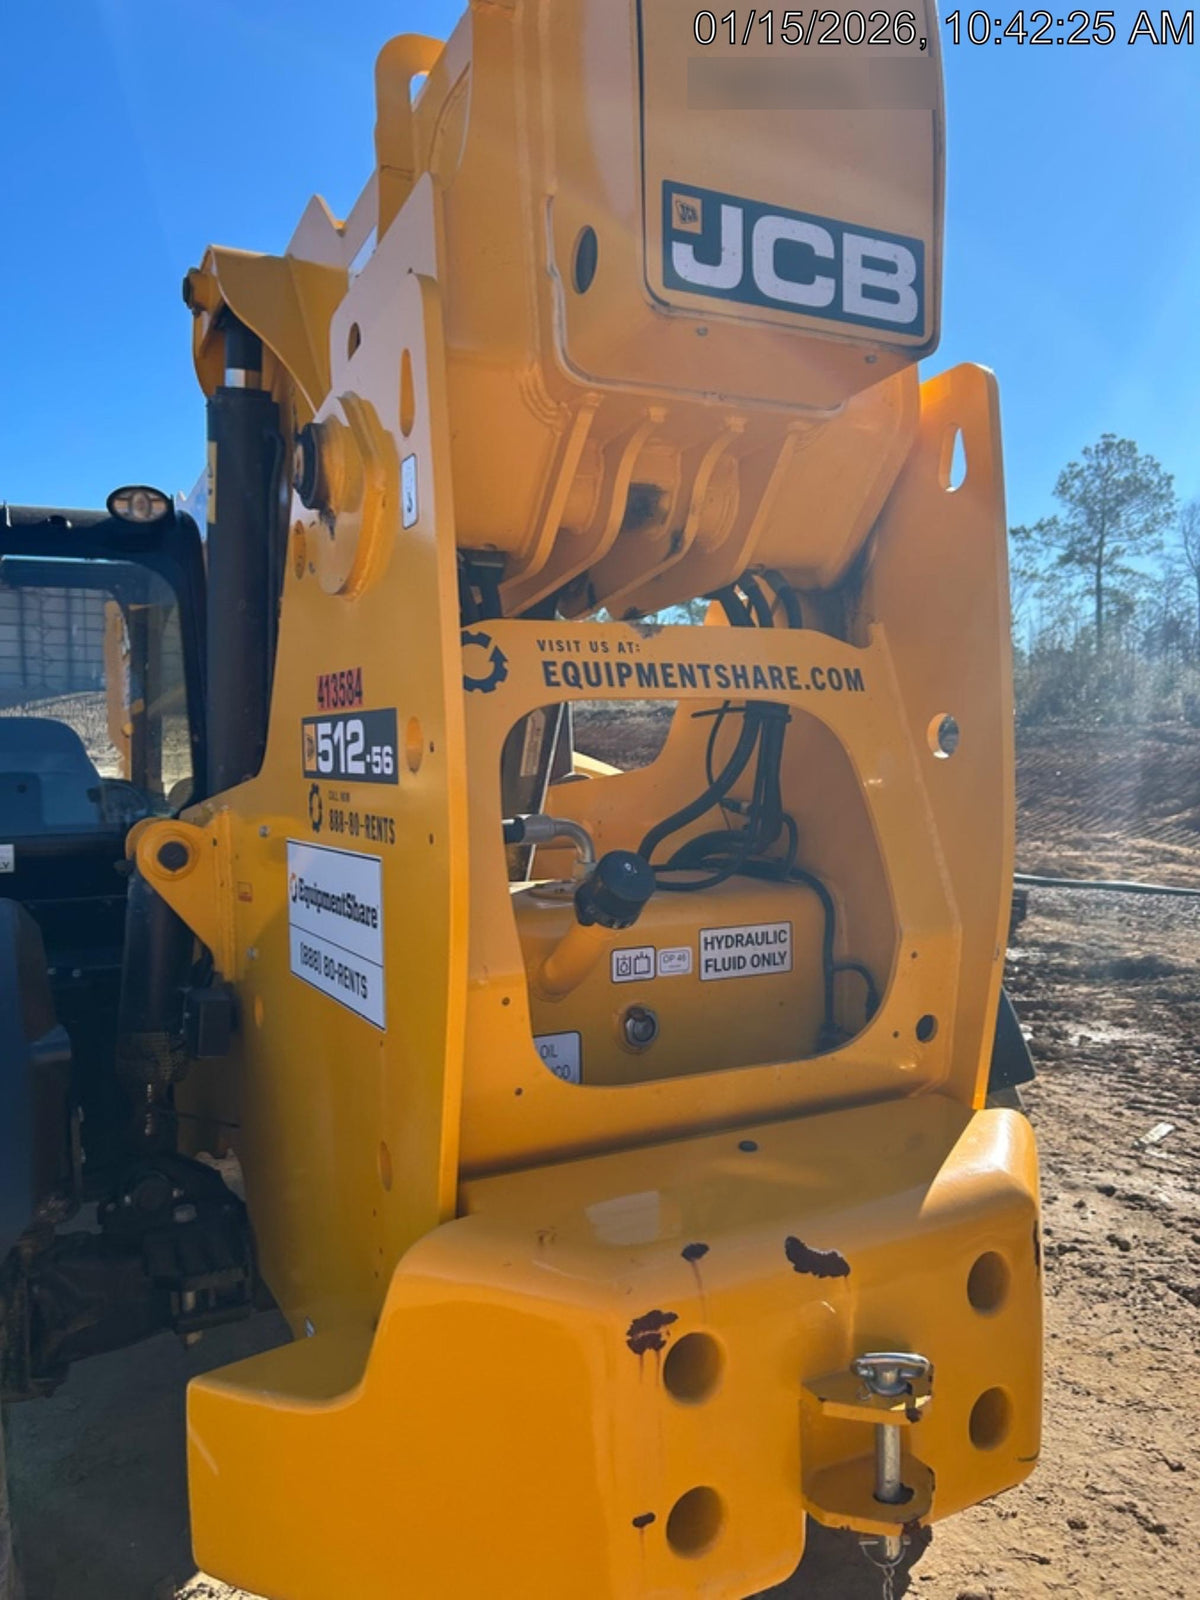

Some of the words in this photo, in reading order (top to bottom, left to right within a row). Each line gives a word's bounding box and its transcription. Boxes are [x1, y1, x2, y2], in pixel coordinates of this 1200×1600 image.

[672, 204, 918, 325] JCB
[536, 639, 581, 652] VISIT
[589, 640, 609, 653] US
[617, 641, 641, 653] AT:
[317, 667, 363, 708] 413584
[541, 660, 865, 692] EQUIPMENTSHARE.COM
[329, 808, 395, 844] 888-80-RENTS
[299, 877, 378, 929] EquipmentShare
[703, 929, 788, 951] HYDRAULIC
[300, 942, 322, 975] (888)
[323, 955, 368, 999] 80-RENTS
[704, 954, 747, 973] FLUID
[750, 951, 788, 969] ONLY
